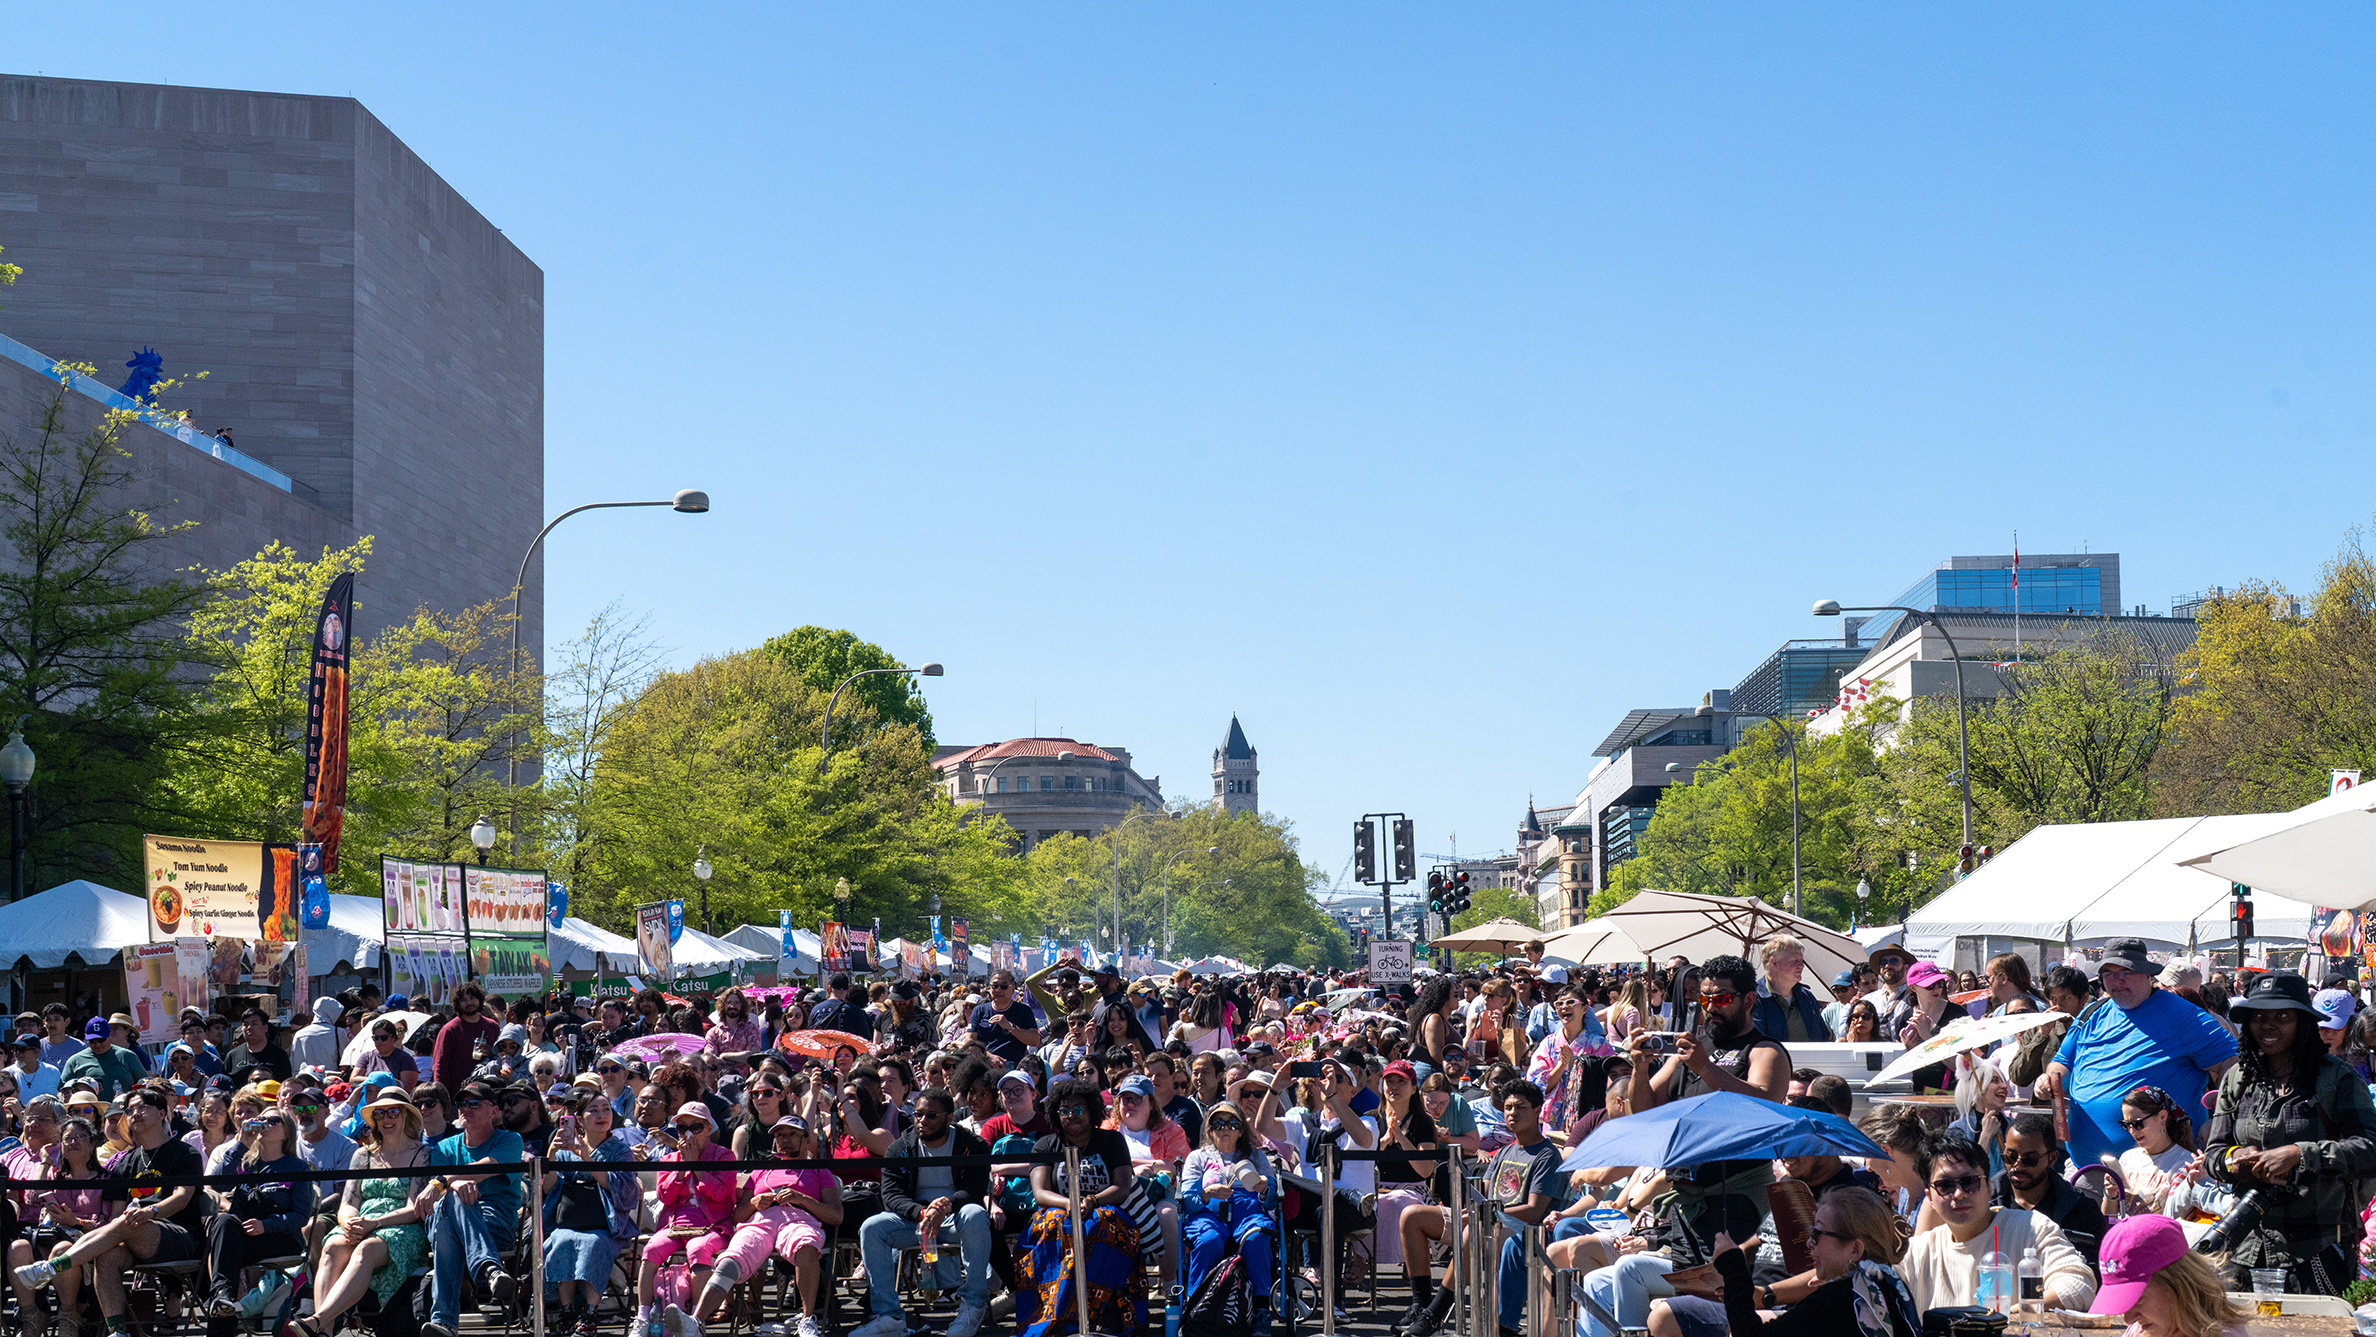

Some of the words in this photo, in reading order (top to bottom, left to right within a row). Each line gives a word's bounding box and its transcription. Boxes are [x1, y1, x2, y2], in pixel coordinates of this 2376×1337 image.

[308, 662, 324, 796] NOODLES
[156, 841, 182, 853] Sesame
[183, 843, 206, 854] Noodle
[173, 861, 189, 872] Tom
[190, 862, 205, 873] Yum
[206, 863, 228, 873] Noodle
[184, 881, 203, 893] Spicy
[204, 882, 226, 892] Peanut
[227, 883, 248, 893] Noodle
[189, 909, 203, 919] Spicy
[204, 909, 220, 918] Garlic
[220, 910, 237, 919] Ginger
[238, 910, 255, 918] Noodle
[672, 919, 682, 927] 23
[139, 945, 174, 956] Smoothie
[1378, 945, 1403, 953] TURNING
[489, 950, 534, 977] TAIYAKI
[1371, 971, 1383, 979] USE
[1385, 971, 1410, 979] X-WALKS
[487, 978, 506, 990] JAPANESE
[524, 978, 542, 988] WAFFLES
[673, 980, 709, 993] Katsu
[93, 1023, 100, 1031] G
[1092, 1176, 1108, 1185] THE
